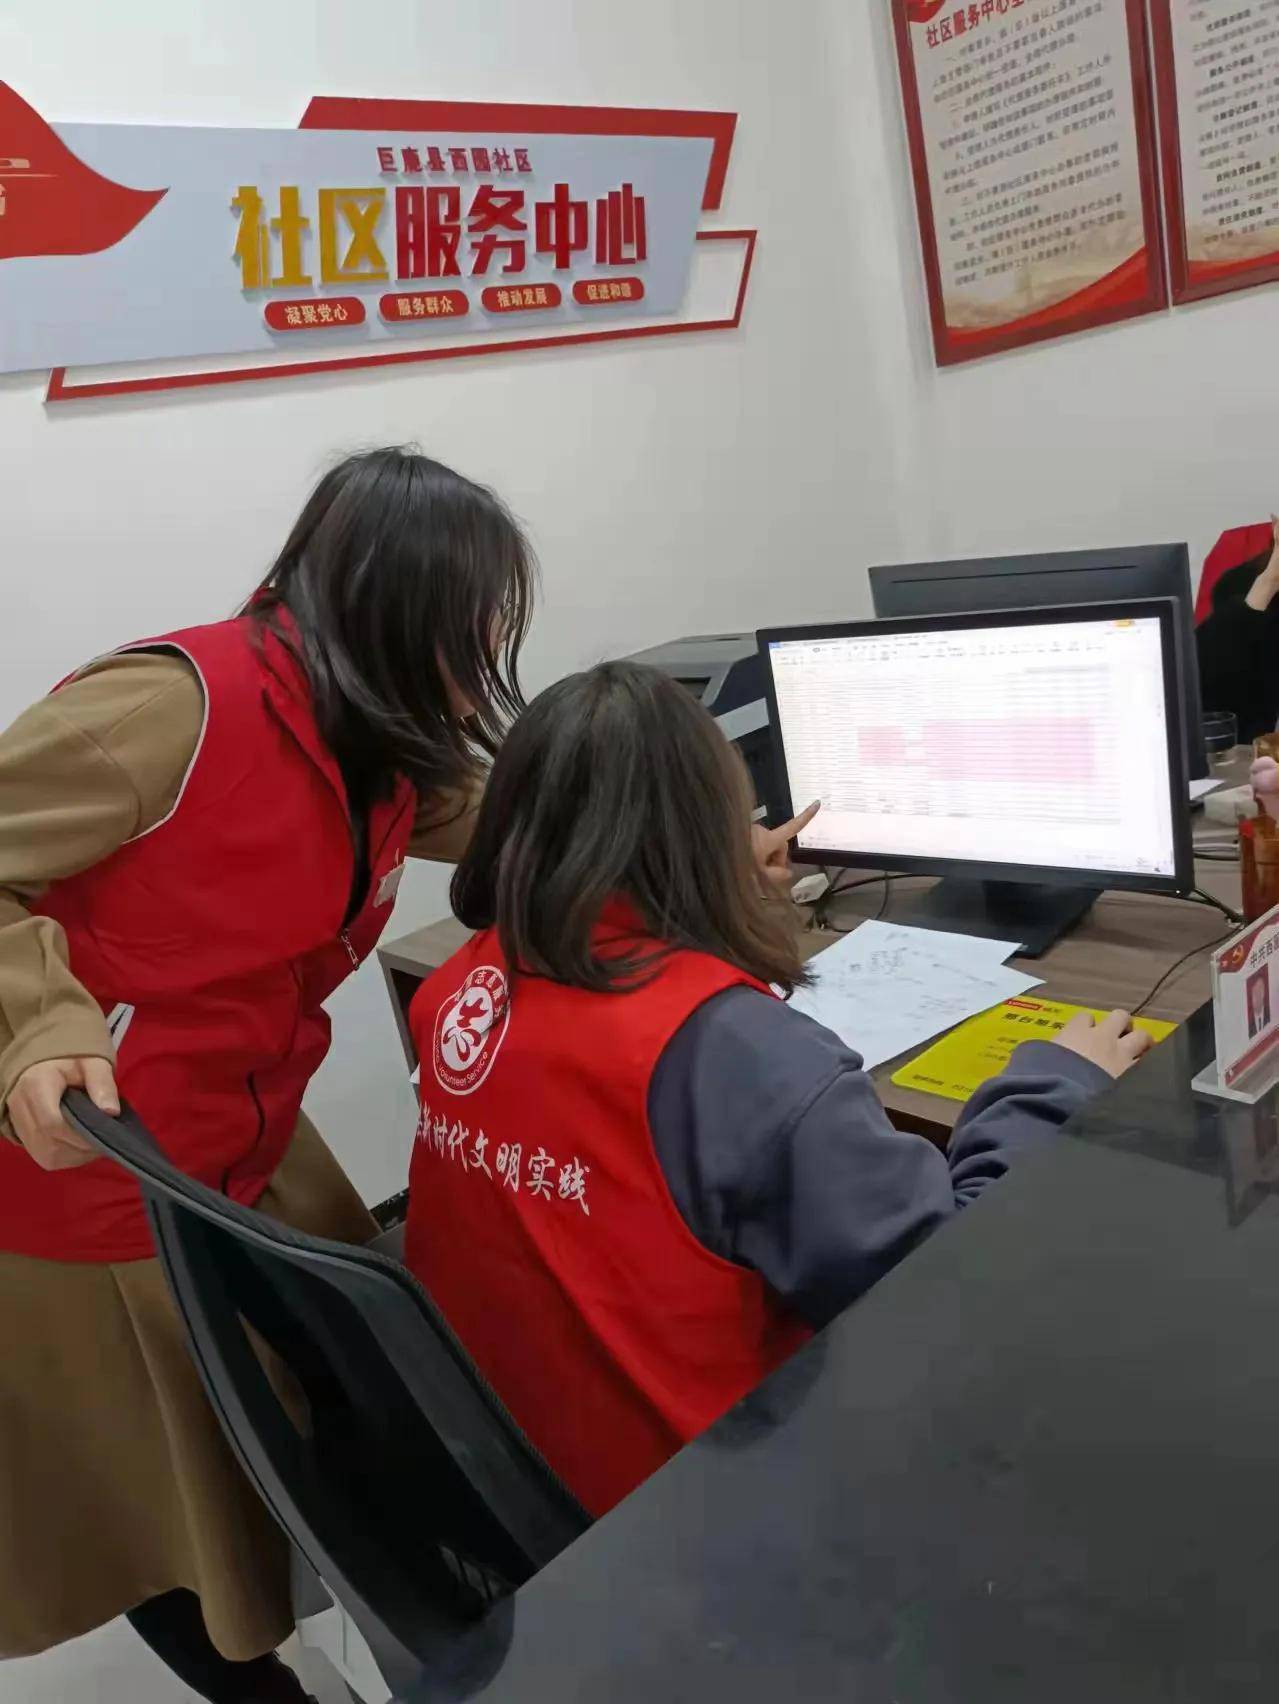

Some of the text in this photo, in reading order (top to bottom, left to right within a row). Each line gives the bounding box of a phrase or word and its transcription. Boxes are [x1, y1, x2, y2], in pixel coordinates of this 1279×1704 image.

[925, 0, 1025, 48] 社区服务中心
[231, 182, 647, 289] 社区服务中心
[397, 295, 455, 317] 服务群众
[496, 286, 549, 308] 推动发展
[284, 303, 349, 326] 凝聚党心
